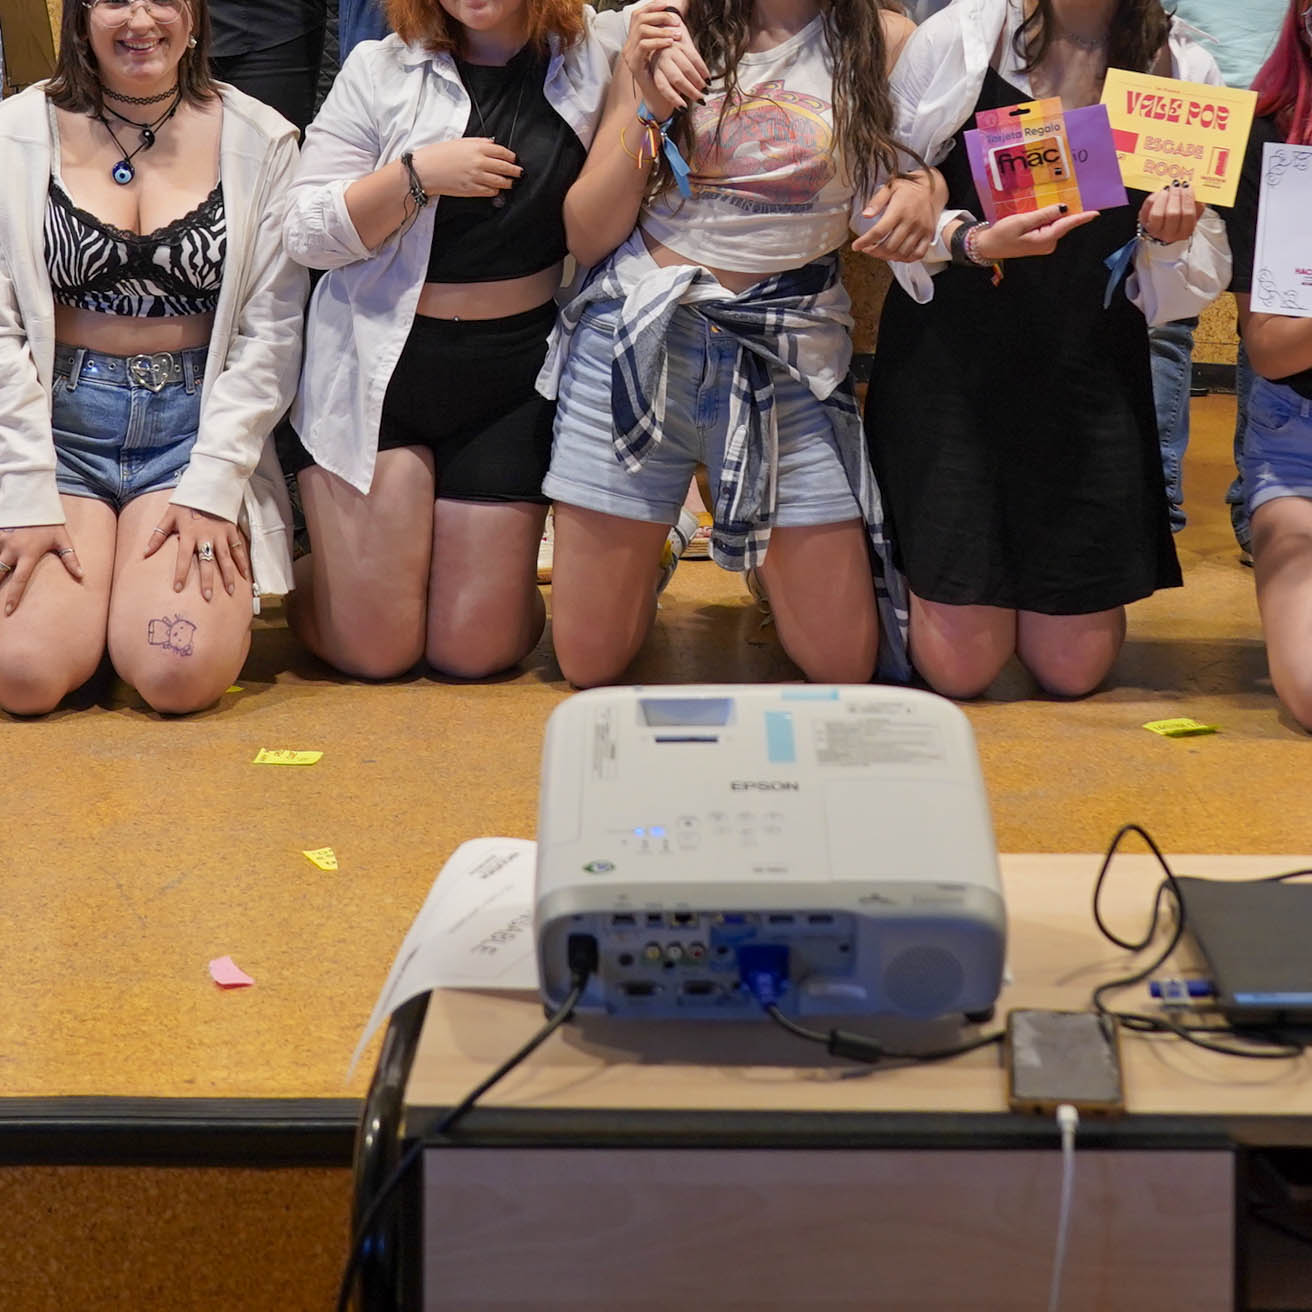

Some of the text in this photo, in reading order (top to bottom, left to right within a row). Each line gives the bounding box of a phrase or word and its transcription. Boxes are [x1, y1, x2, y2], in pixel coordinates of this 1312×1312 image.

[1126, 90, 1230, 131] VALE POR
[1024, 123, 1061, 137] Regalo
[1143, 136, 1204, 159] ESCAPE
[998, 148, 1060, 174] fnac
[1143, 159, 1194, 180] ROOM
[731, 781, 799, 791] EPSON
